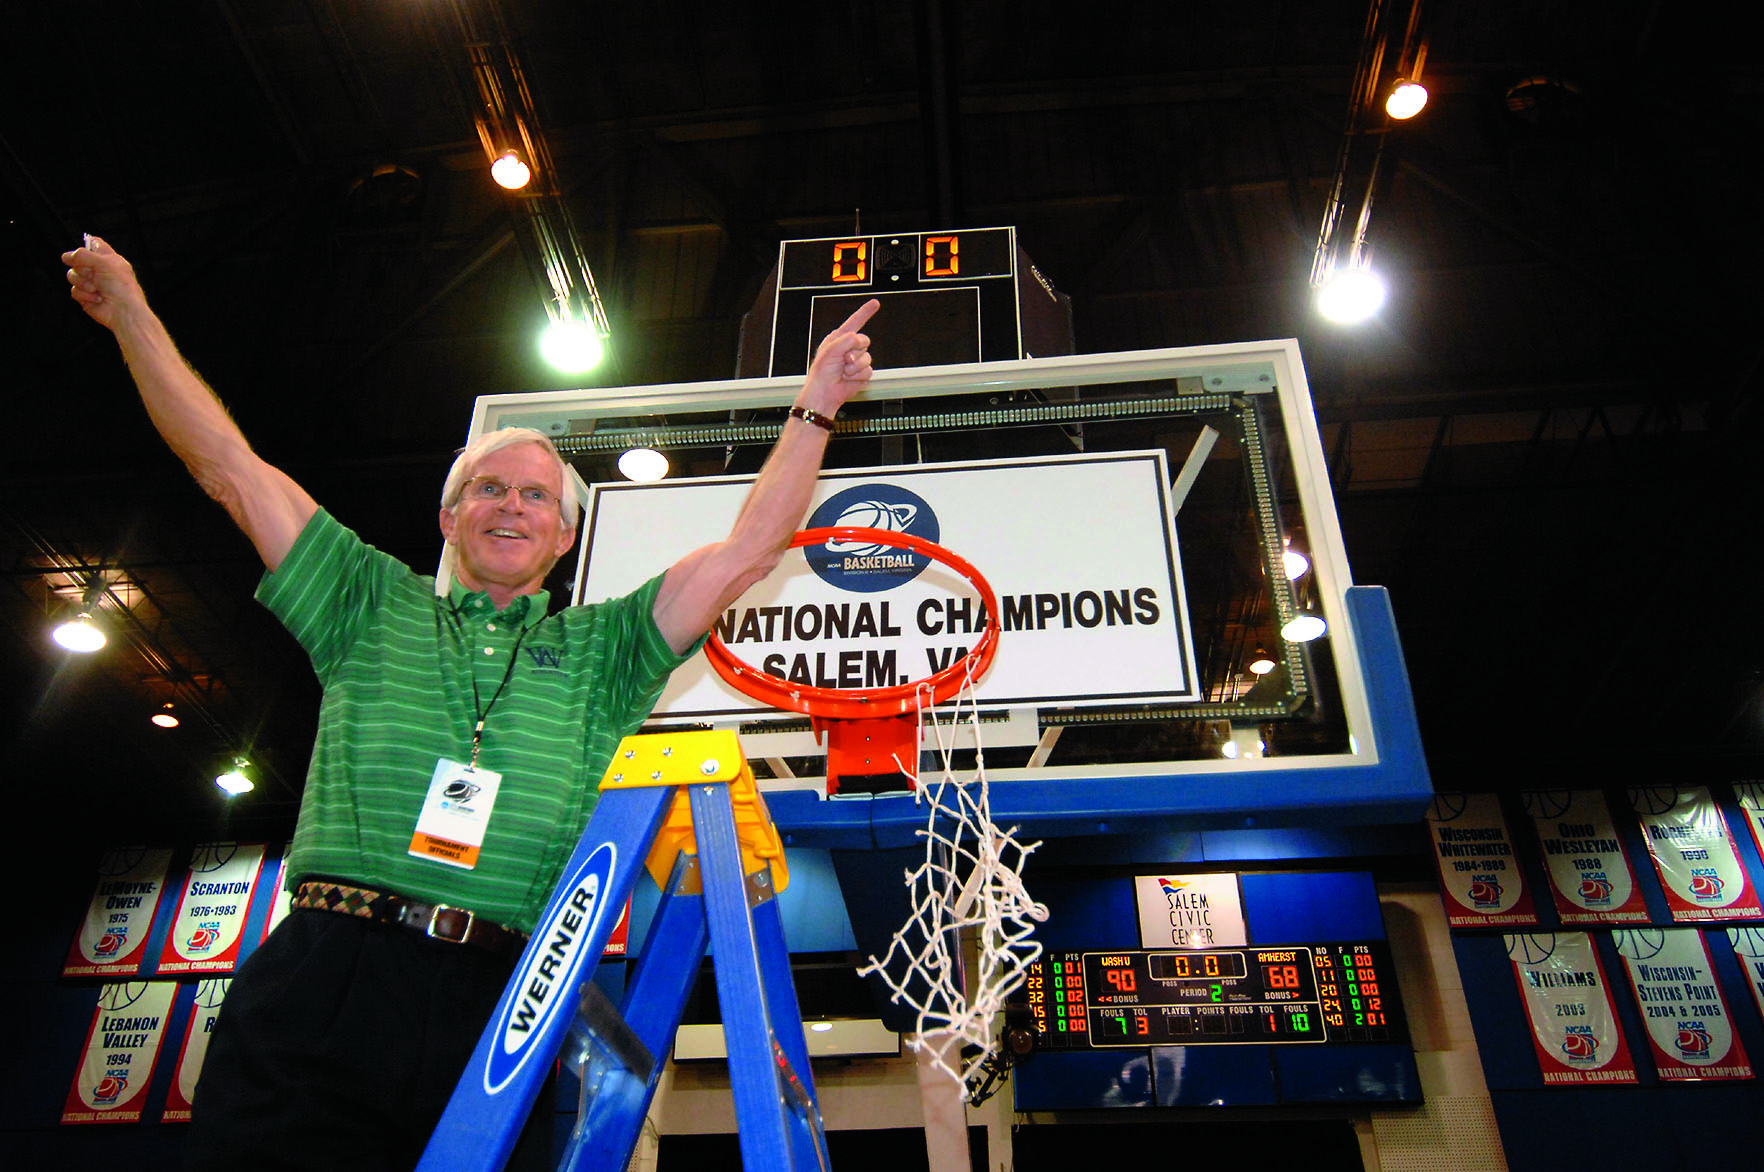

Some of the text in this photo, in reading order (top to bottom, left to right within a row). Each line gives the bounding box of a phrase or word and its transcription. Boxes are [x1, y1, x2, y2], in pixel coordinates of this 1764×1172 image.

[832, 242, 866, 282] 0
[926, 236, 959, 276] 0
[844, 554, 915, 570] BASKETBALL
[713, 588, 1160, 644] NATIONAL CHAMPIONS
[1438, 827, 1504, 841] WISCONSIN
[1558, 823, 1595, 838] OHIO
[1438, 842, 1512, 857] WHITEWATER
[1543, 839, 1620, 855] WESLEYAN
[1572, 858, 1602, 870] 1988
[190, 882, 249, 896] SCRANTON
[106, 896, 142, 909] OWEN
[1167, 893, 1209, 910] SALEM
[108, 913, 128, 923] 1975
[1170, 910, 1211, 927] CIVIC
[1450, 914, 1536, 925] NATIONAL CHAMPIONS
[1600, 912, 1648, 920] CHAMPIONS
[1672, 907, 1761, 918] NATIONAL CHAMPIONS
[1172, 928, 1214, 945] CENER
[510, 887, 594, 1032] WERNER
[1258, 952, 1296, 962] AMHERST
[1315, 954, 1373, 967] 05 0 00
[64, 964, 138, 975] NATIONAL CHAMPIONS
[159, 961, 234, 971] NATIONAL CHAMPIONS
[1031, 962, 1081, 974] 14 0 01
[1638, 964, 1702, 982] WISCONSIN-
[1106, 969, 1136, 991] 90
[1268, 965, 1299, 988] 68
[1322, 968, 1376, 982] 11 0 00
[1527, 970, 1596, 988] WILLIAMS
[1028, 976, 1082, 989] 22 0 00
[1320, 983, 1379, 996] 20 0 00
[1029, 990, 1083, 1003] 32 0 02
[1180, 988, 1207, 997] PERIOD
[1210, 984, 1222, 1002] 2
[1637, 983, 1717, 1002] STEVENS POINT
[1034, 1004, 1085, 1017] 15 0 00
[1323, 997, 1381, 1011] 24 0 12
[1555, 1003, 1586, 1016] 2003
[1647, 1004, 1720, 1018] 2004 & 2005
[1100, 1009, 1124, 1017] FOULS
[1162, 1007, 1190, 1015] PLAYER
[1196, 1007, 1224, 1015] POINTS
[1229, 1006, 1254, 1014] FOULS
[101, 1016, 159, 1032] LEBANON
[1058, 1019, 1066, 1032] 0
[1069, 1019, 1086, 1032] 00
[1115, 1013, 1310, 1035] 7 3 1 10
[1326, 1012, 1385, 1026] 40 2 01
[1678, 1021, 1705, 1029] NCAA
[1565, 1025, 1592, 1034] NCAA
[103, 1033, 149, 1048] VALLEY
[106, 1053, 132, 1065] 1994
[1544, 1070, 1635, 1082] NATIONAL CHAMPIONS
[1657, 1066, 1751, 1078] NATIONAL CHAMPIONS
[63, 1111, 140, 1121] NATIONAL CHAMPIONS
[163, 1111, 191, 1119] NATION
